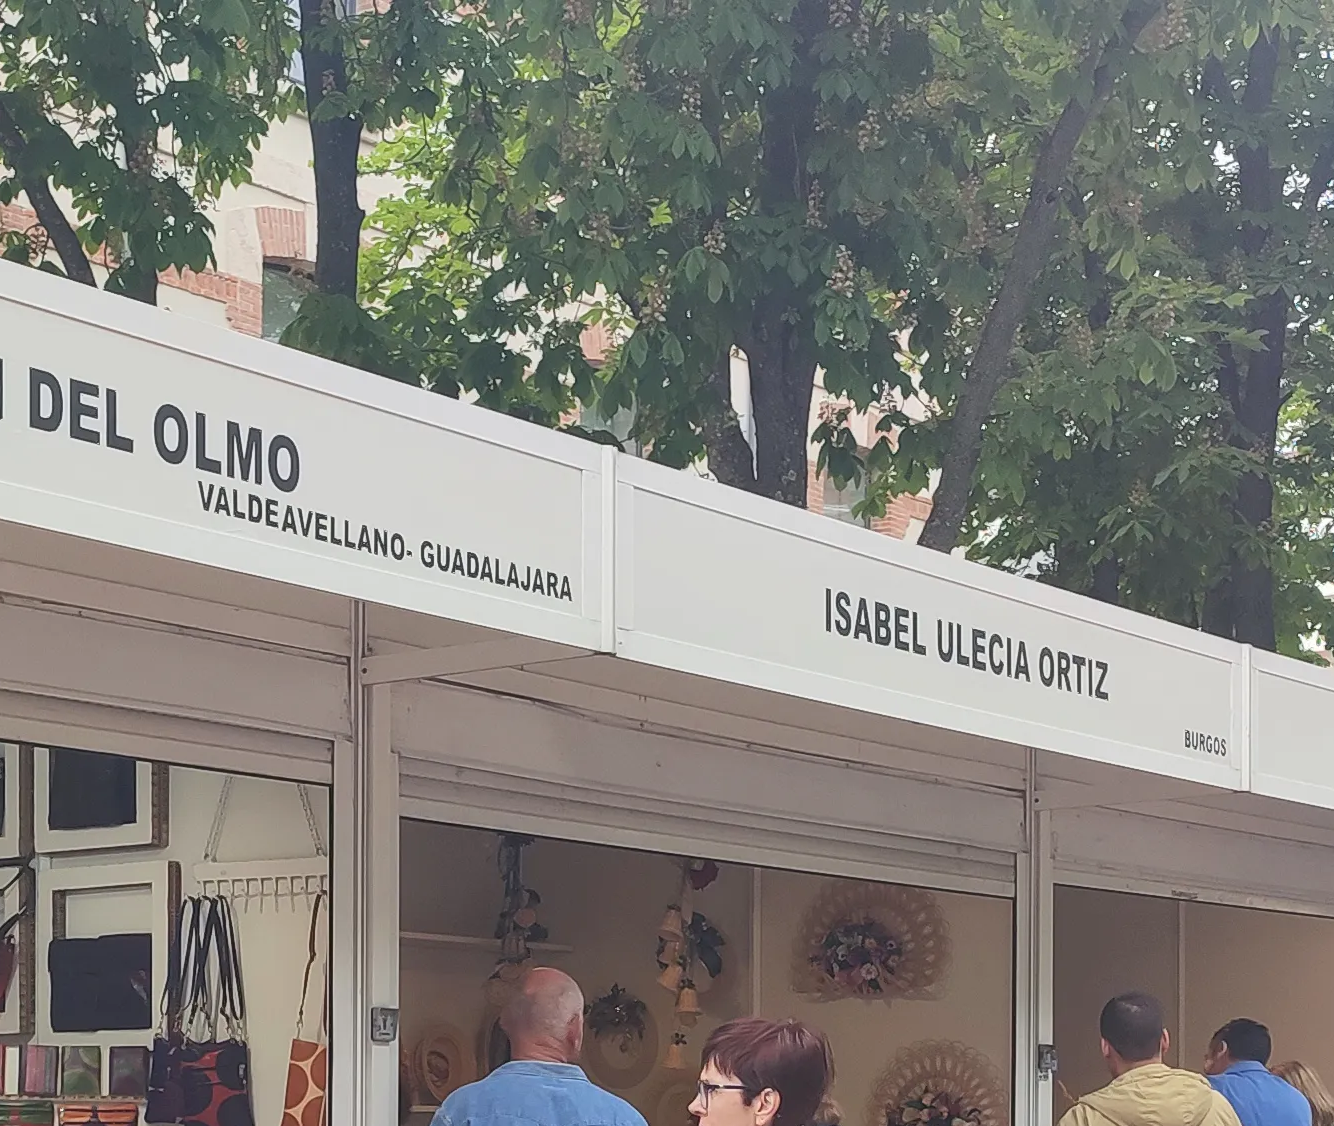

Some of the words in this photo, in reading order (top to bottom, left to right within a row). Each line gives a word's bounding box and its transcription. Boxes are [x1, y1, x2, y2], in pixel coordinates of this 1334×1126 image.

[28, 367, 134, 453] DEL
[153, 404, 300, 493] OLMO
[420, 541, 573, 602] GUADALAJARA
[825, 588, 927, 656] ISABEL
[937, 619, 1031, 683] ULECIA
[1038, 646, 1109, 701] ORTIZ
[1184, 729, 1227, 757] BURGOS
